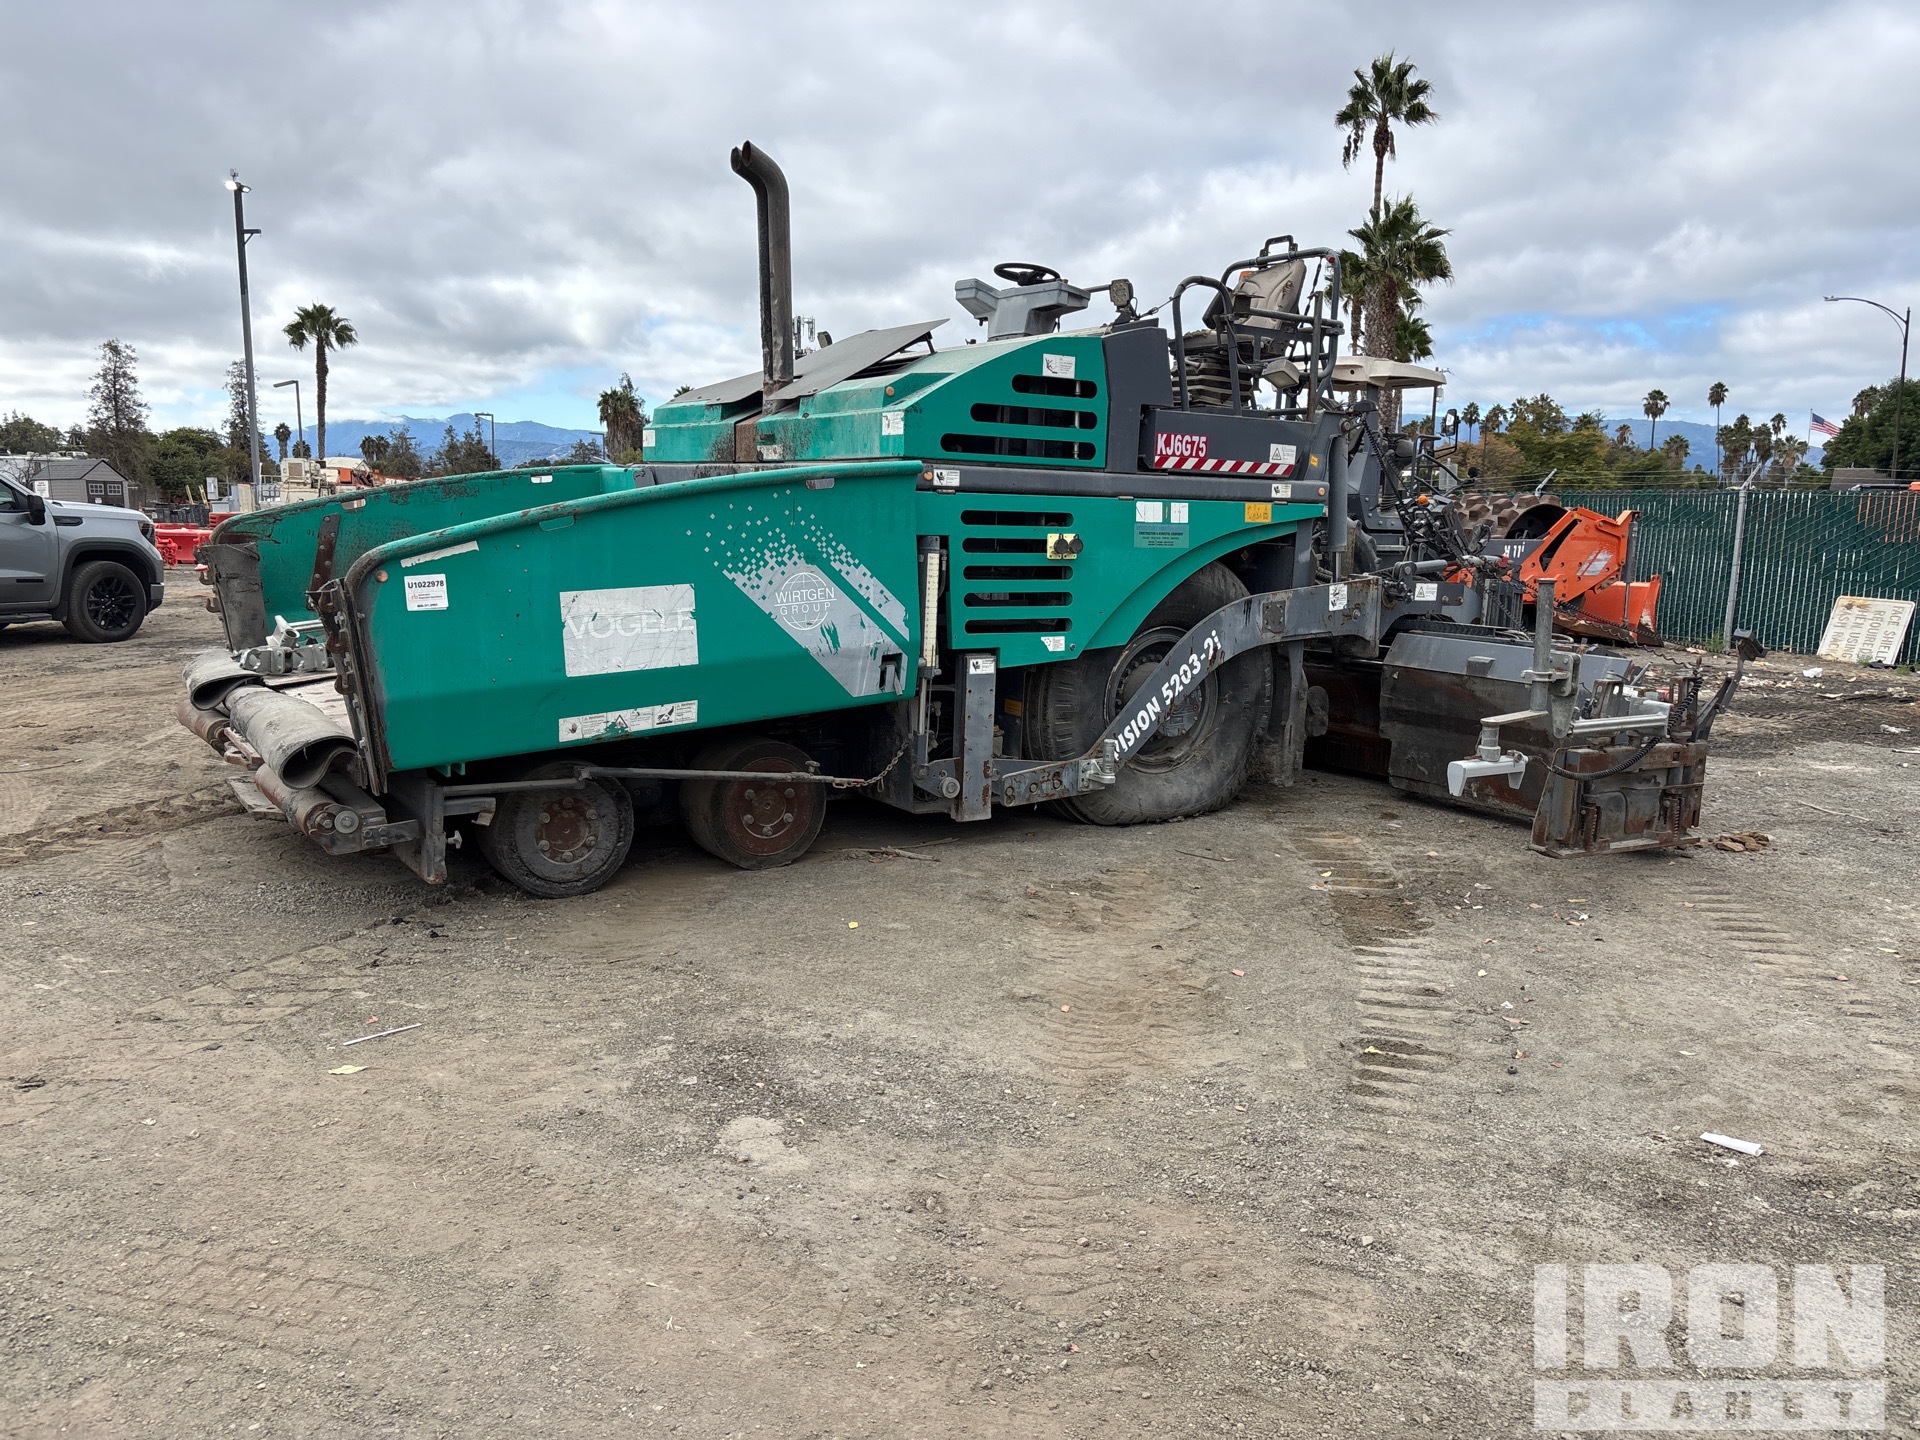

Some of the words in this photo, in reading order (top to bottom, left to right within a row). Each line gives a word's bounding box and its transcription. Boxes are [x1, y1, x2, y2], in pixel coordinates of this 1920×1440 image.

[1157, 433, 1207, 457] KJ6G75
[407, 580, 445, 589] U1022978
[775, 587, 835, 604] WIRTGEN
[780, 602, 831, 616] GROUP
[1834, 602, 1853, 628] ASH
[1887, 606, 1905, 626] FACE
[1841, 632, 1860, 659] USING
[1860, 610, 1886, 656] REQUIRED
[1875, 630, 1897, 662] SHIELD
[1161, 629, 1222, 706] 5203-2i
